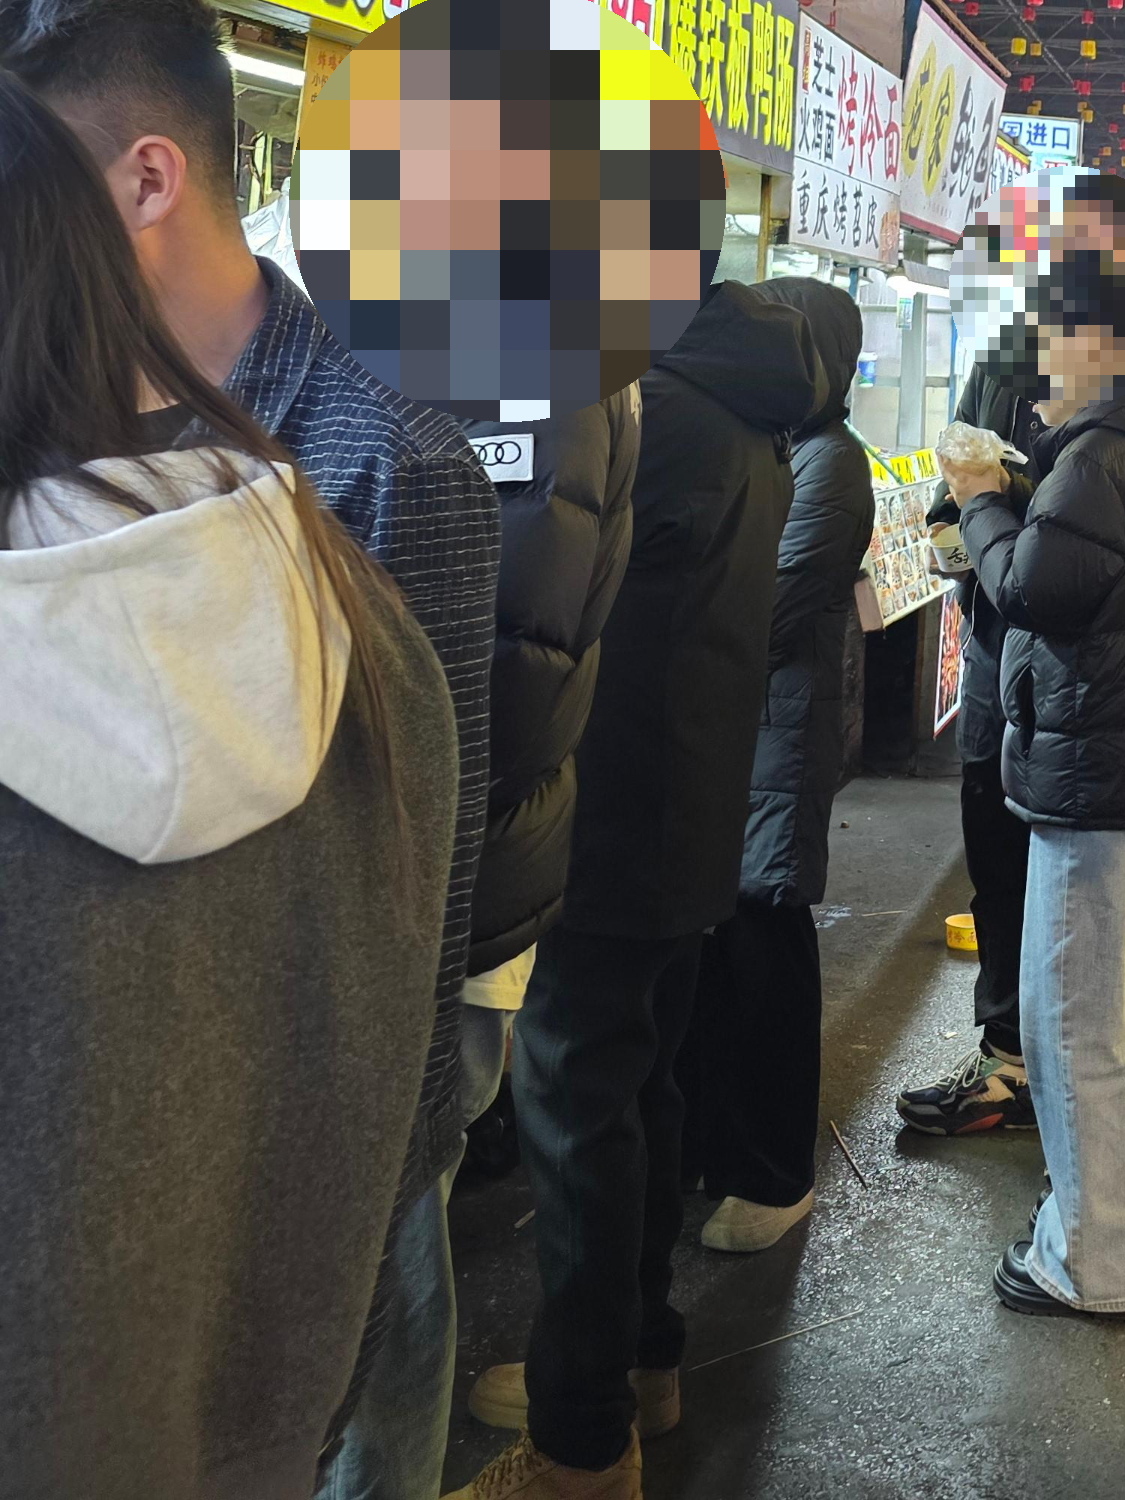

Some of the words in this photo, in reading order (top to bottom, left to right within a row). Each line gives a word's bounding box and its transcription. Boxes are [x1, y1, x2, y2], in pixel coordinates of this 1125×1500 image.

[811, 36, 836, 98] 芝士
[798, 98, 836, 162] 火鸡面
[837, 50, 901, 182] 烤冷面
